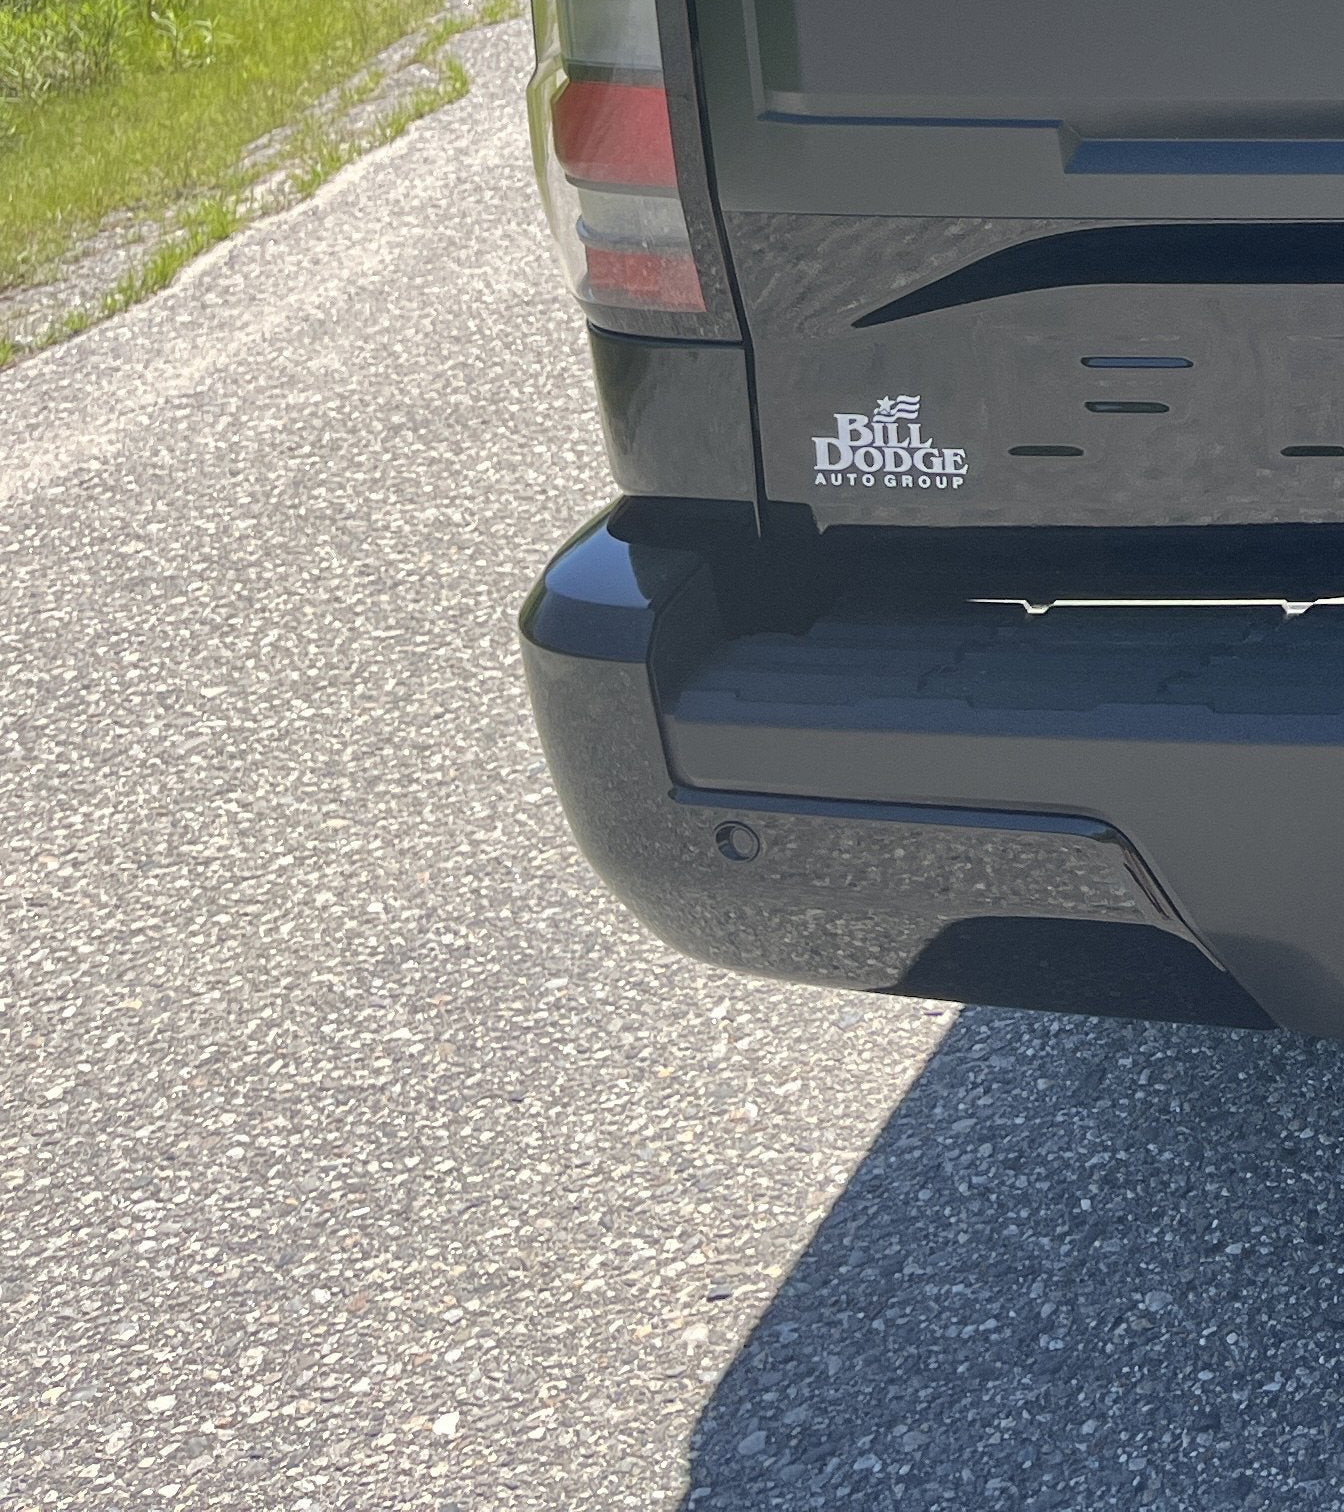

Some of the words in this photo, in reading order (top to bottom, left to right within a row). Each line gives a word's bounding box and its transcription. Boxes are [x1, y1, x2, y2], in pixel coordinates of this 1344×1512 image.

[832, 413, 933, 448] BILL
[811, 436, 969, 475] DODGE
[814, 472, 876, 487] AUTO
[883, 474, 965, 489] GROUP
